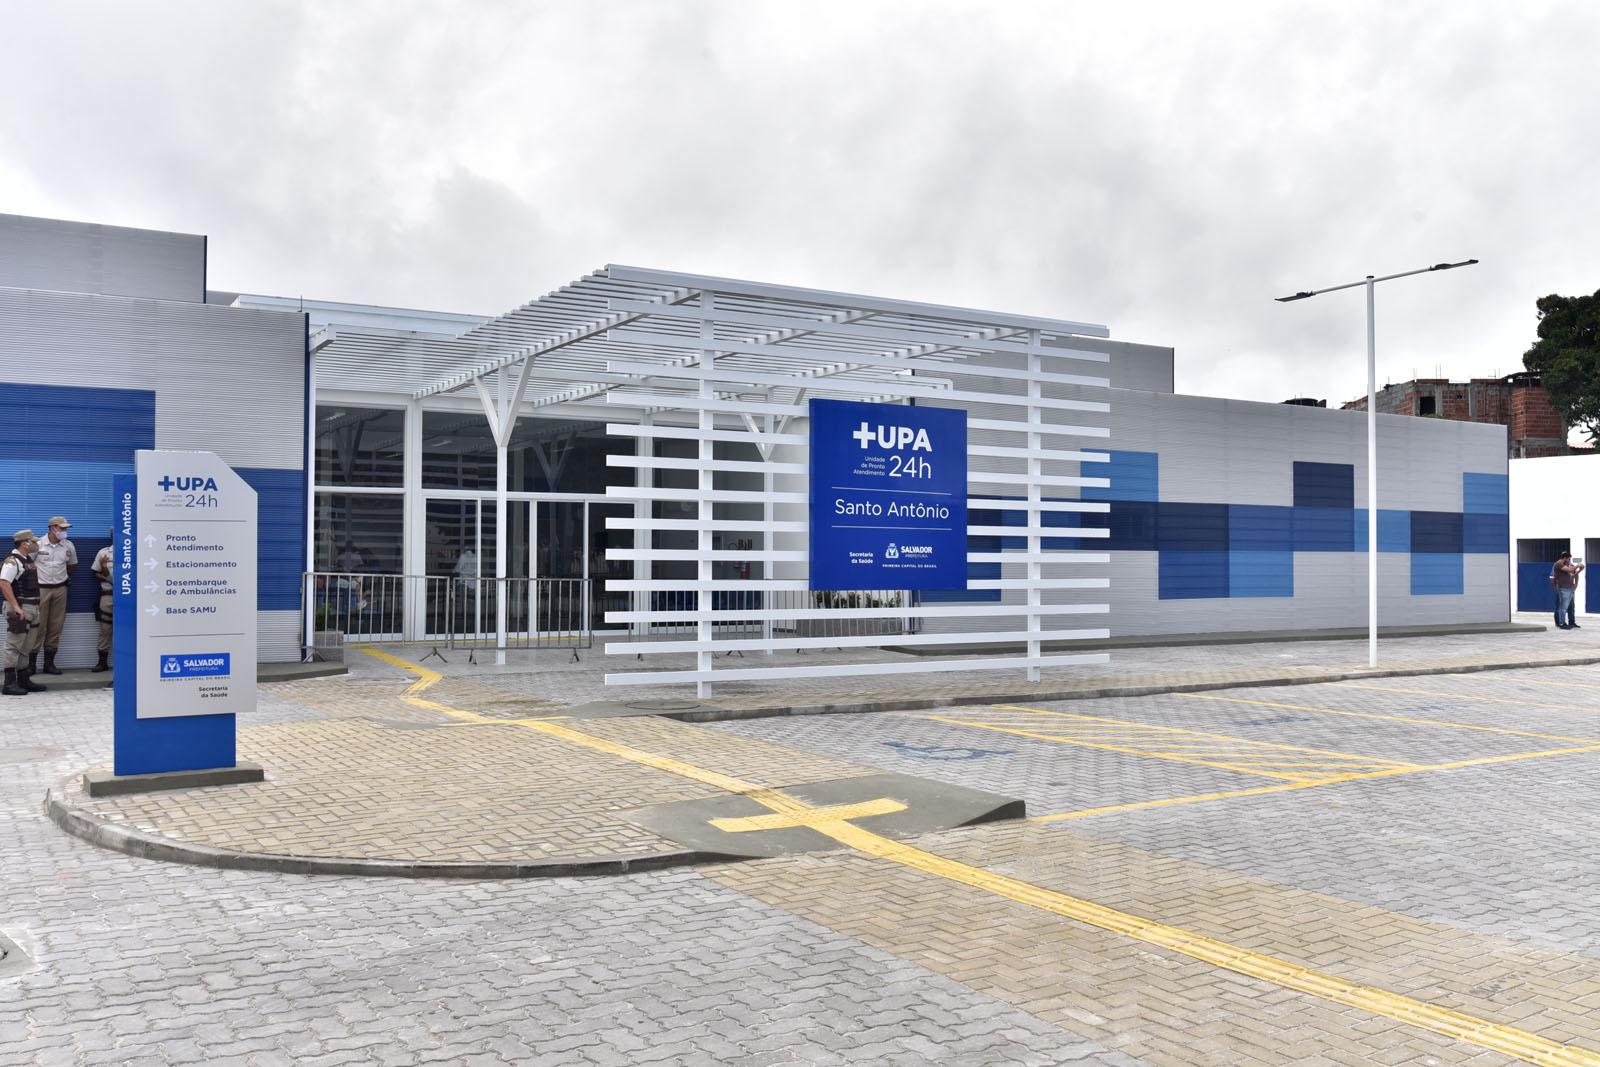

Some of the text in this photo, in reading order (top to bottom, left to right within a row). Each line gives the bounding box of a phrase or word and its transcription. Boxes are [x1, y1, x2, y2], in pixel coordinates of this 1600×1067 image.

[889, 455, 932, 479] 24h
[185, 494, 218, 508] 24h
[835, 499, 950, 519] Santo Antônio
[122, 492, 132, 595] UPA Santo Antônio
[900, 546, 932, 554] SALVADOR
[180, 587, 236, 595] Ambulâncias
[184, 658, 224, 667] SALVADOR
